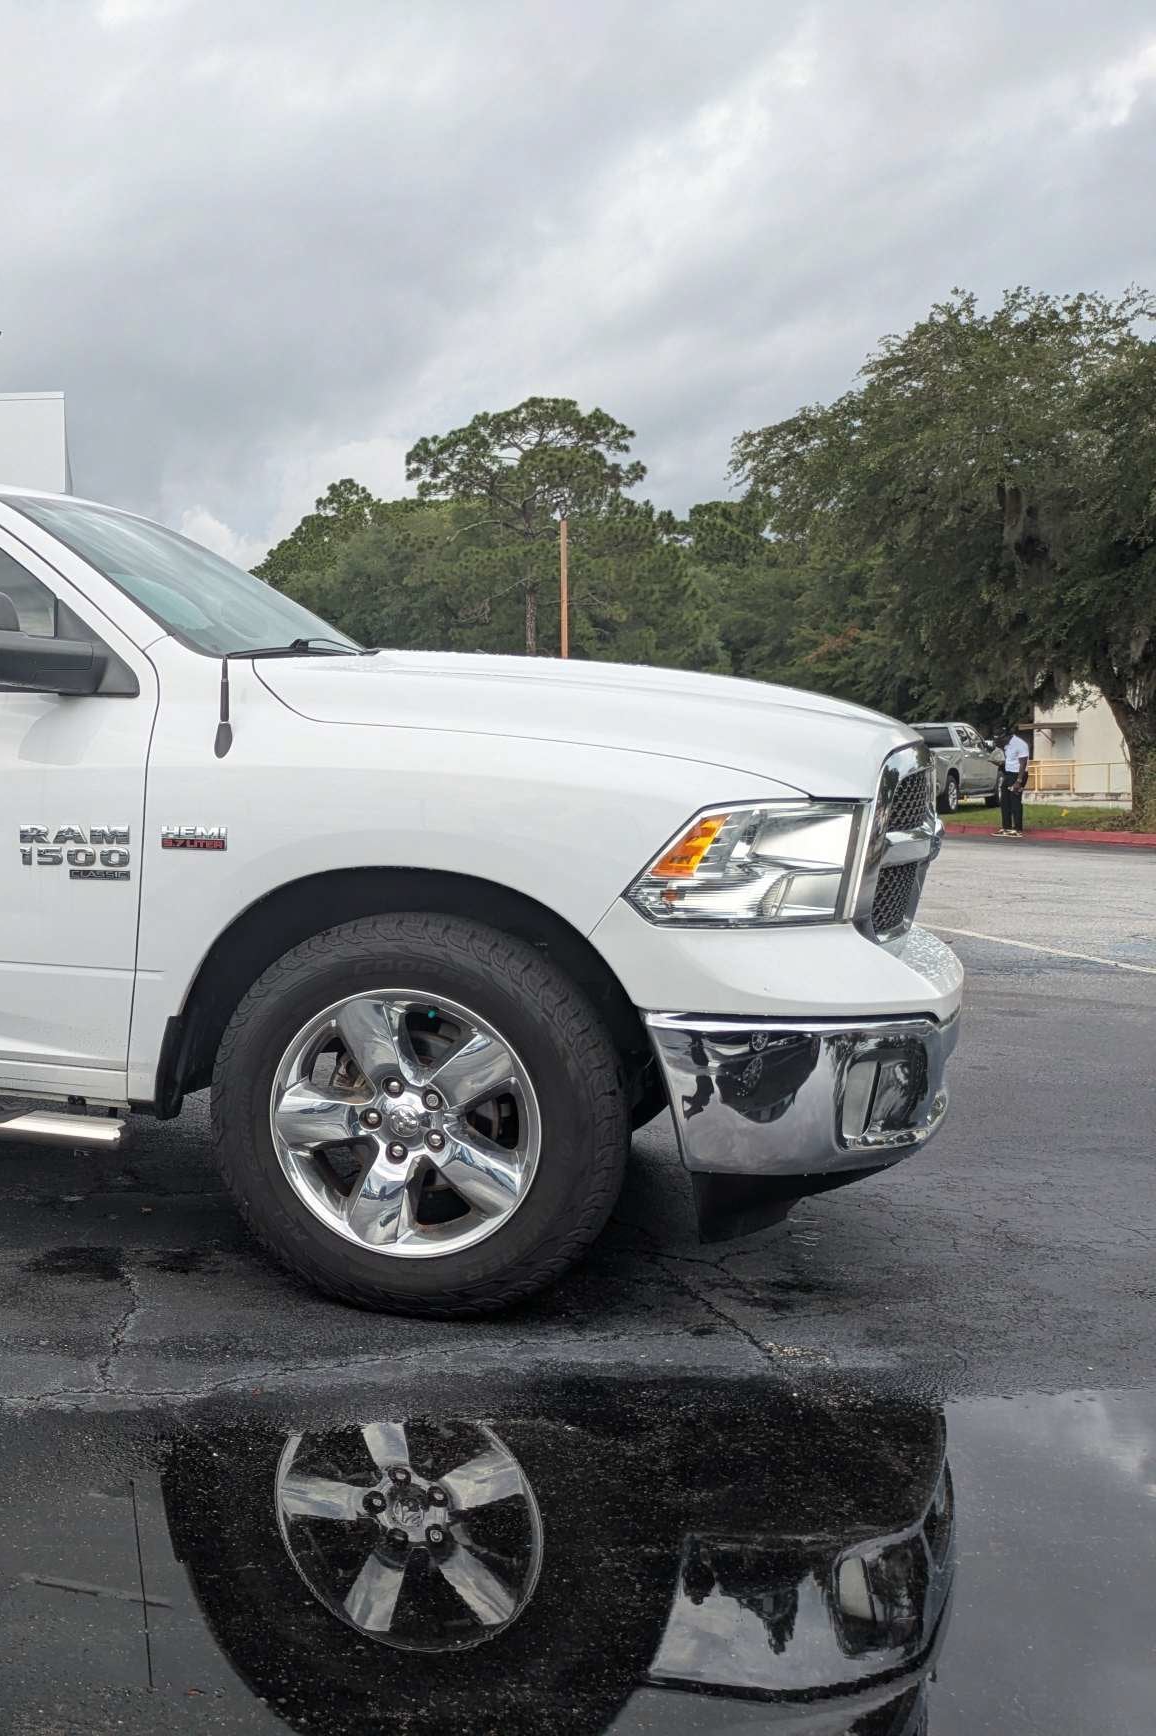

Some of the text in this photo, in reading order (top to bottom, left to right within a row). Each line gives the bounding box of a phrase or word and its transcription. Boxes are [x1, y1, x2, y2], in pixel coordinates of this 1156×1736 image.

[19, 824, 130, 844] RAM
[161, 825, 226, 838] HEMI
[19, 846, 130, 867] 1500
[70, 870, 130, 880] CLASSIC
